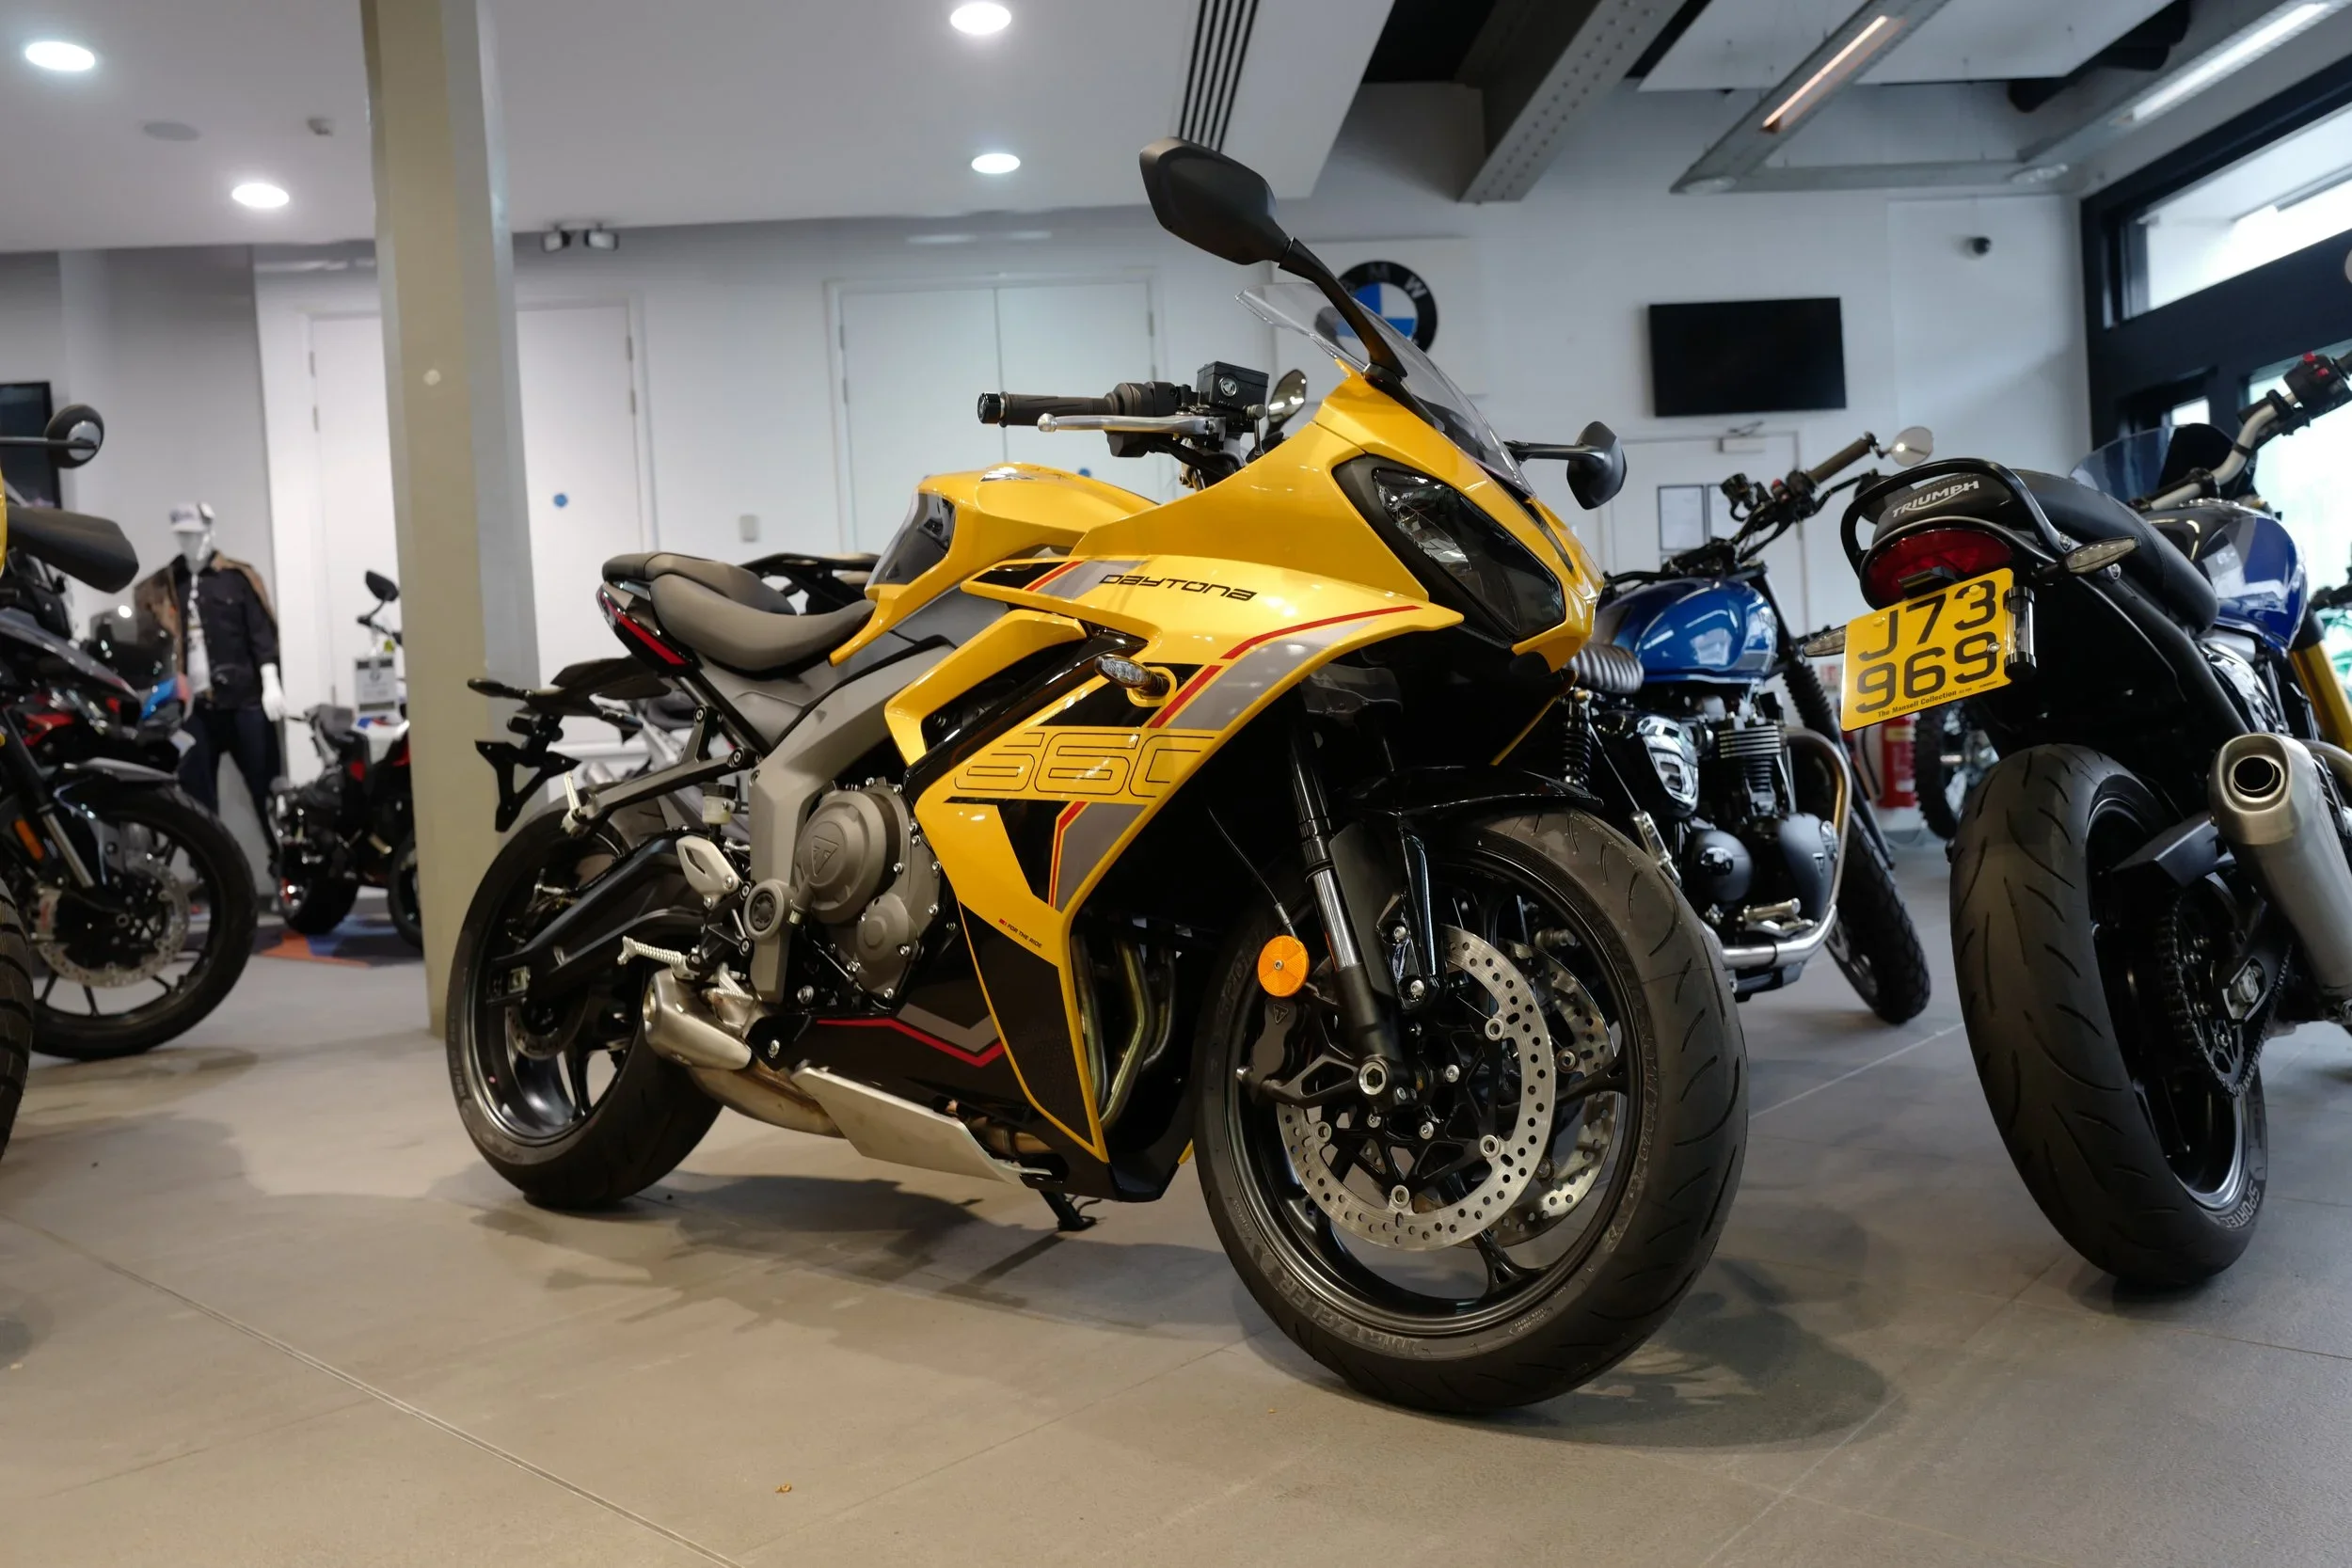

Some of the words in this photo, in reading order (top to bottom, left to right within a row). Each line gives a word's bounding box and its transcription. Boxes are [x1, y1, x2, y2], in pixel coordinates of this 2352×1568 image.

[1891, 480, 1979, 518] TRIUMPH
[1858, 579, 1996, 662] J73
[1855, 631, 1997, 714] 969
[1878, 709, 1890, 718] The
[1892, 701, 1919, 713] Mansell
[1920, 690, 1957, 705] Collection
[1008, 923, 1019, 933] FOR
[1018, 930, 1029, 941] THE
[1029, 937, 1042, 948] RIDE
[2219, 1179, 2261, 1228] SPORTEC
[1279, 1275, 1417, 1357] METZELER
